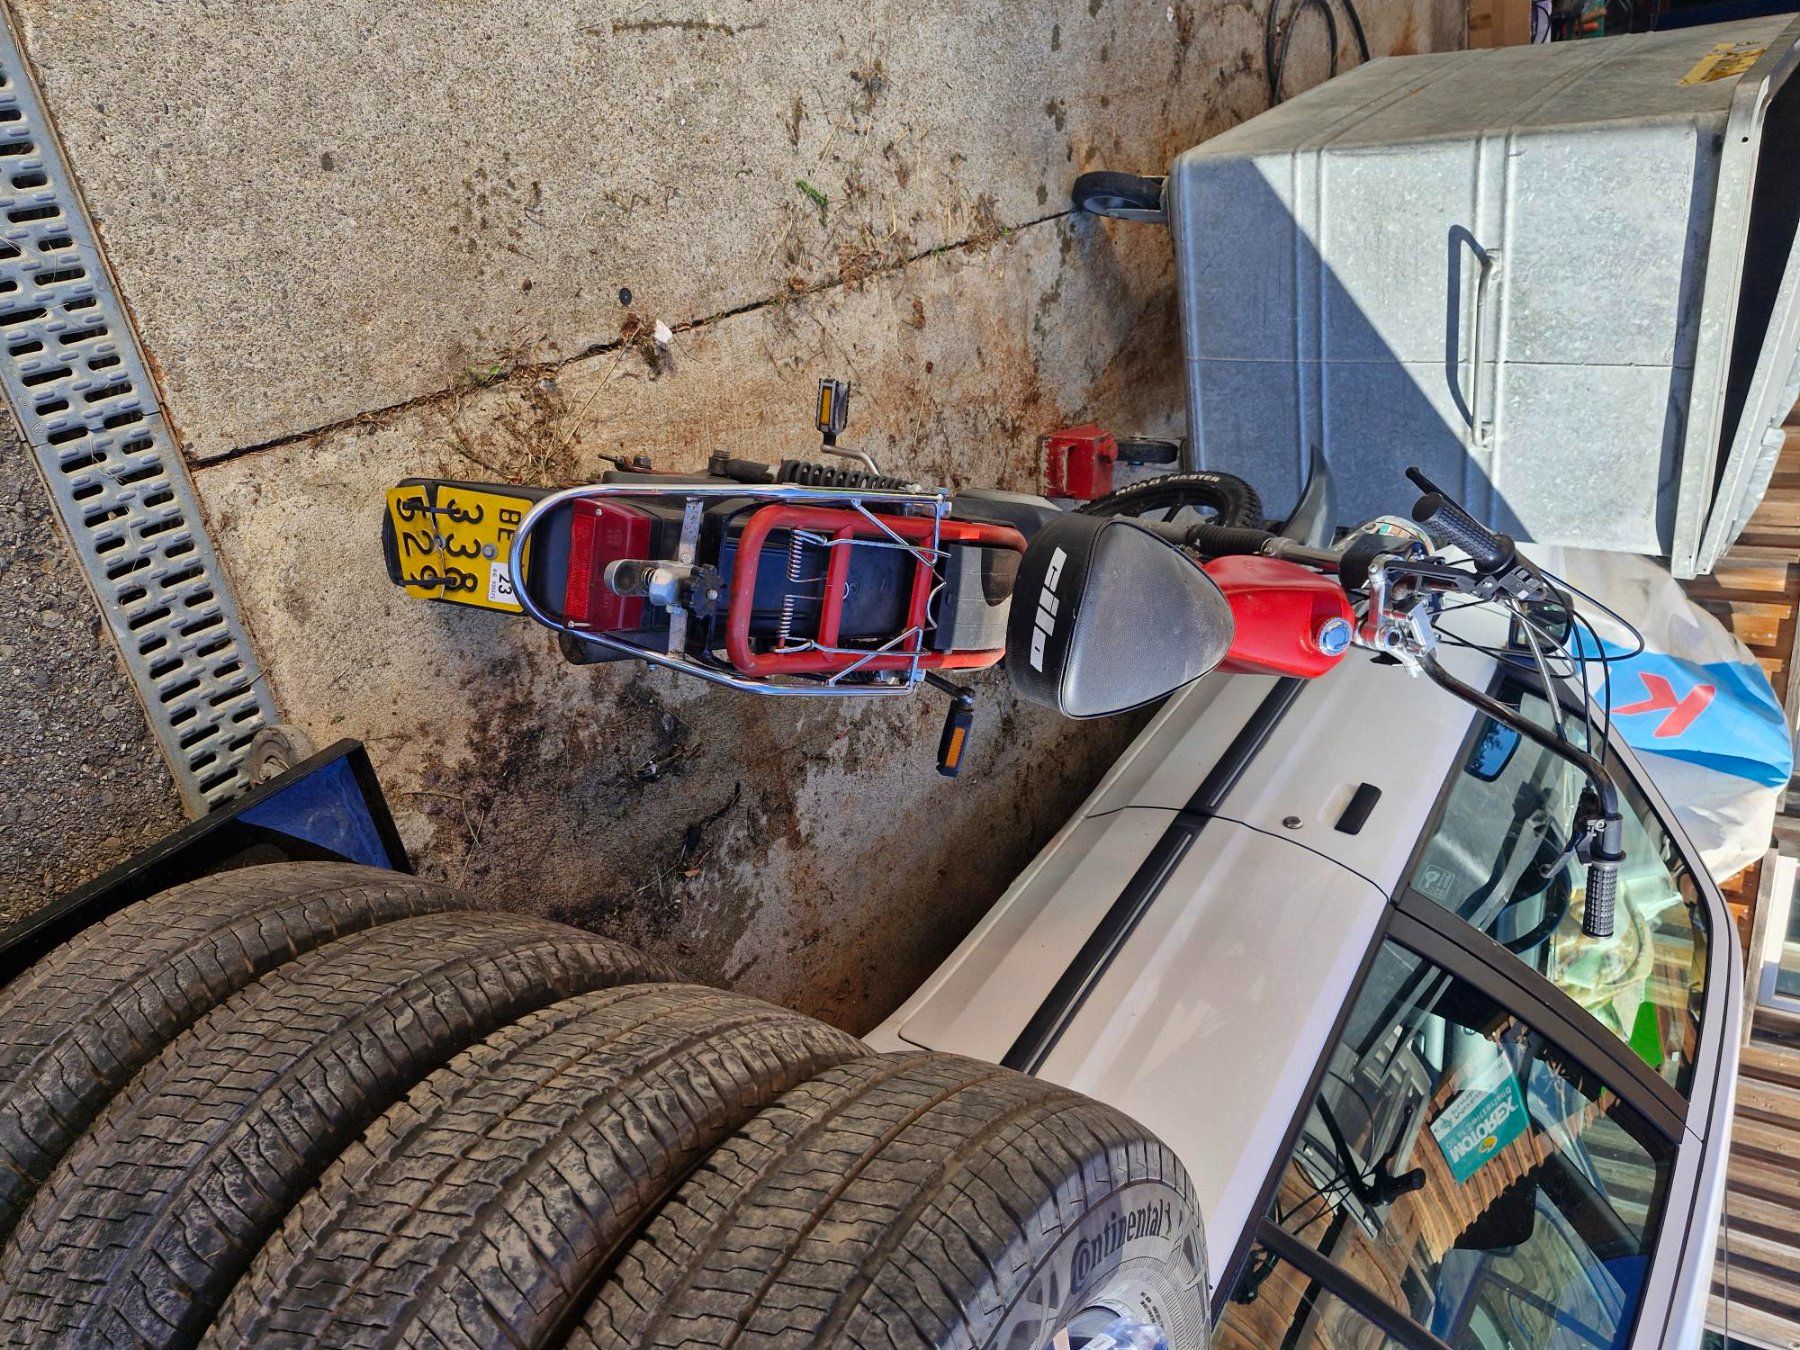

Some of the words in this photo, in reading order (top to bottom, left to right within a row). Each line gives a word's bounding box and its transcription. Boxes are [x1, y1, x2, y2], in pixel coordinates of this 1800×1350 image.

[1168, 474, 1220, 483] MASTER
[396, 496, 440, 589] 529
[445, 499, 484, 592] 338
[498, 508, 521, 542] BE
[498, 574, 512, 594] 23
[1070, 1199, 1163, 1295] Continental
